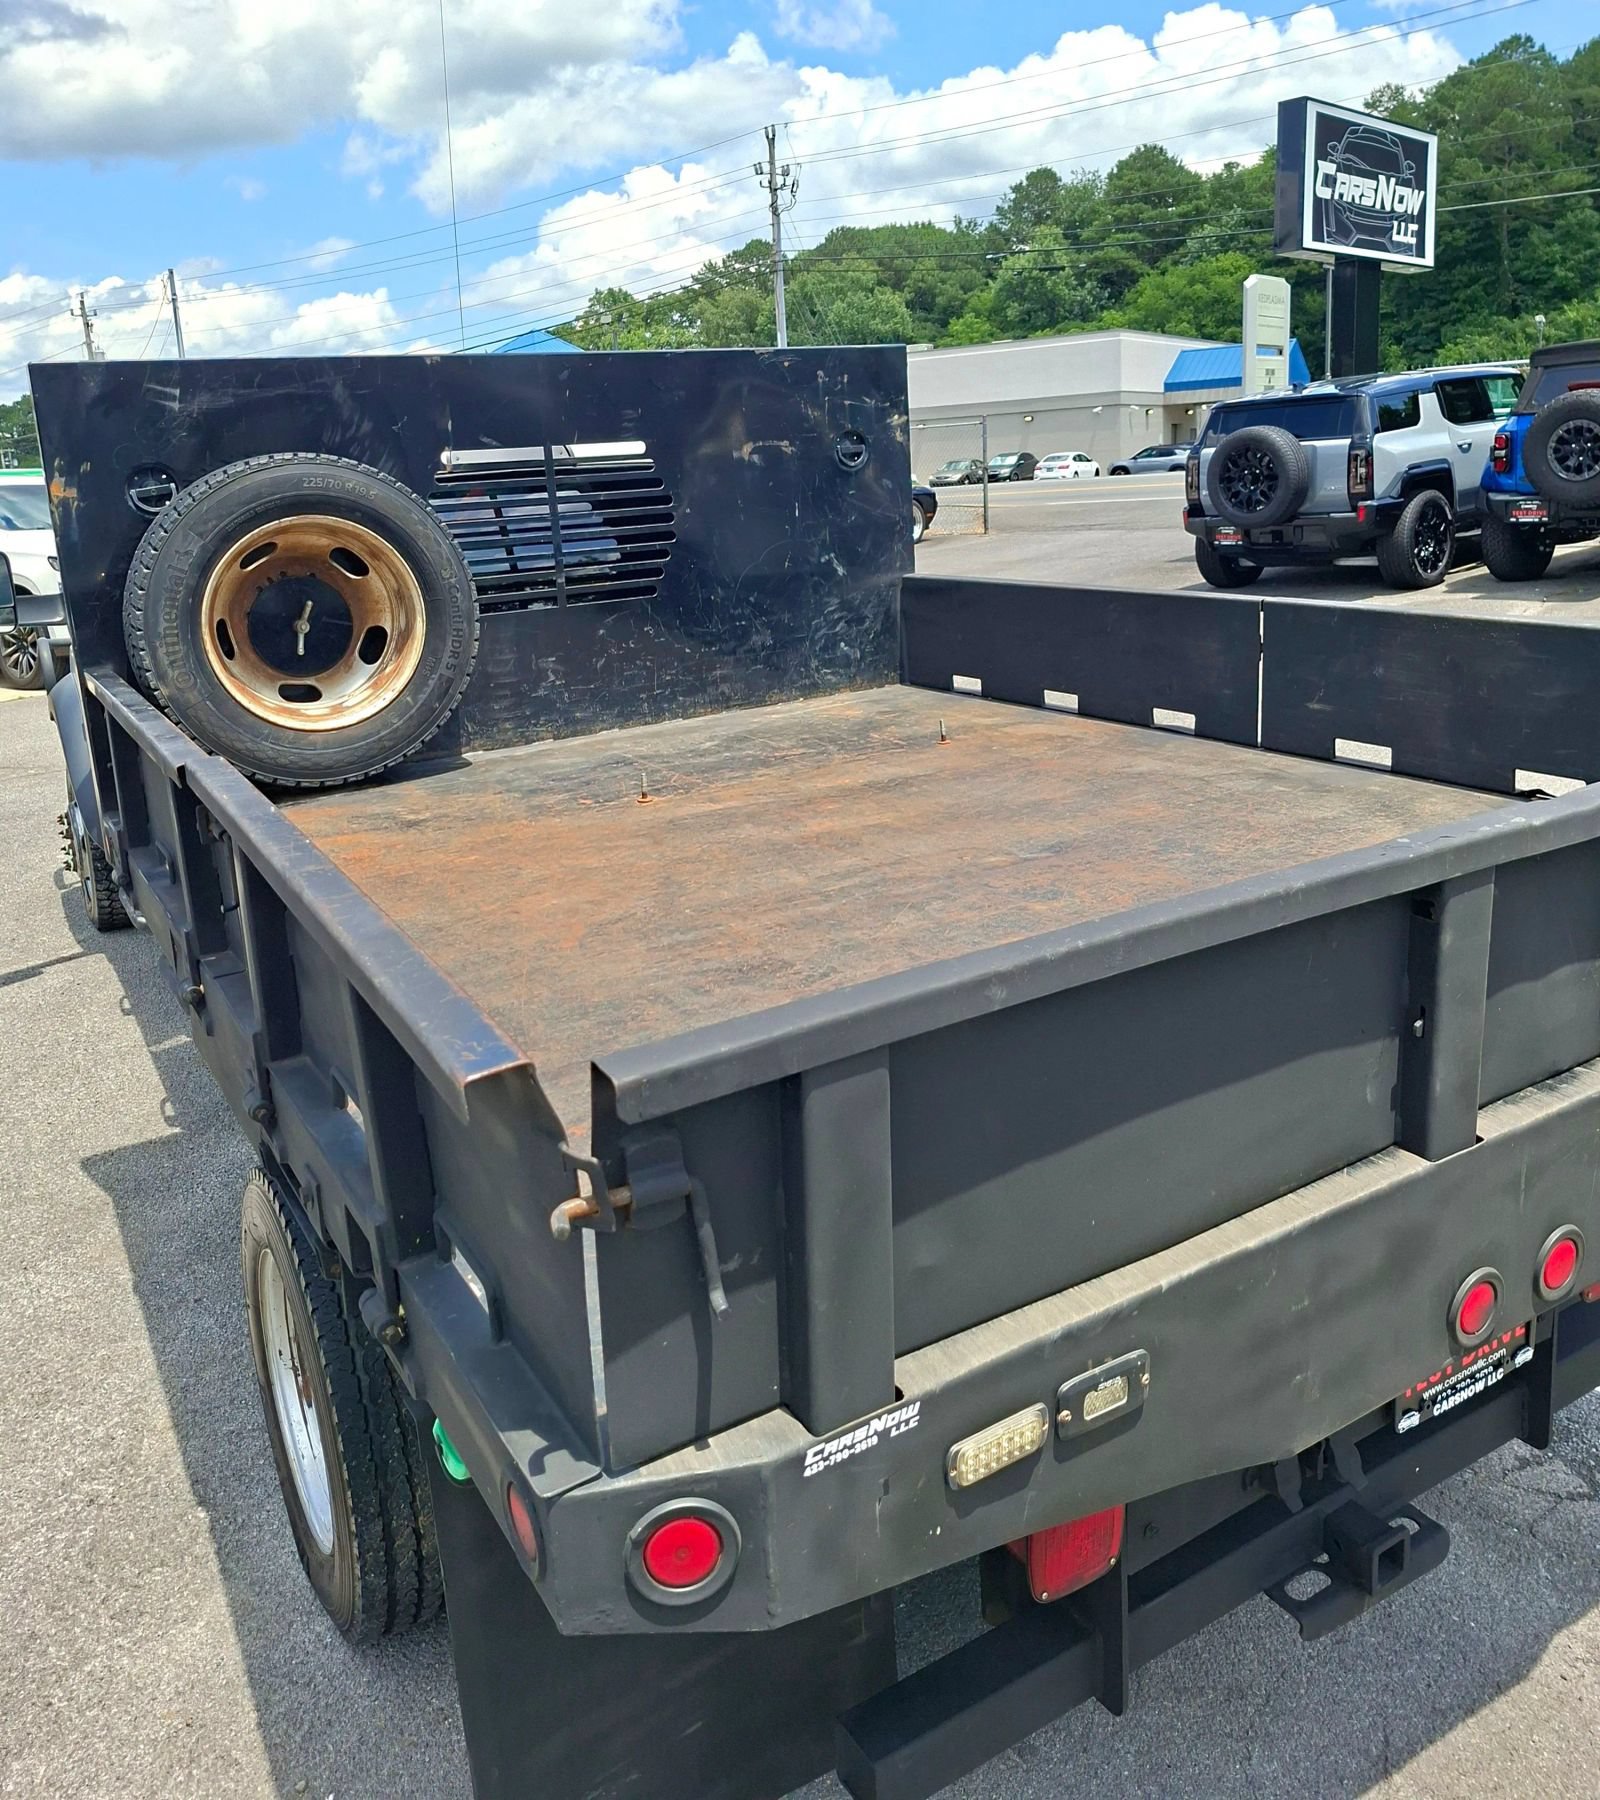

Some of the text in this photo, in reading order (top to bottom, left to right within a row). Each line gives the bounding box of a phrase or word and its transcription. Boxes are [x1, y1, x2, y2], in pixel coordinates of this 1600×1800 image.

[1392, 221, 1419, 244] LLC
[303, 477, 377, 500] 225/70 R 19.5
[160, 564, 197, 692] Continental
[1422, 1347, 1507, 1400] www.carsnowllc.com
[1433, 1368, 1504, 1416] CARSNOW LLC
[890, 1415, 920, 1437] LLC
[803, 1435, 878, 1477] 423-790-2619
